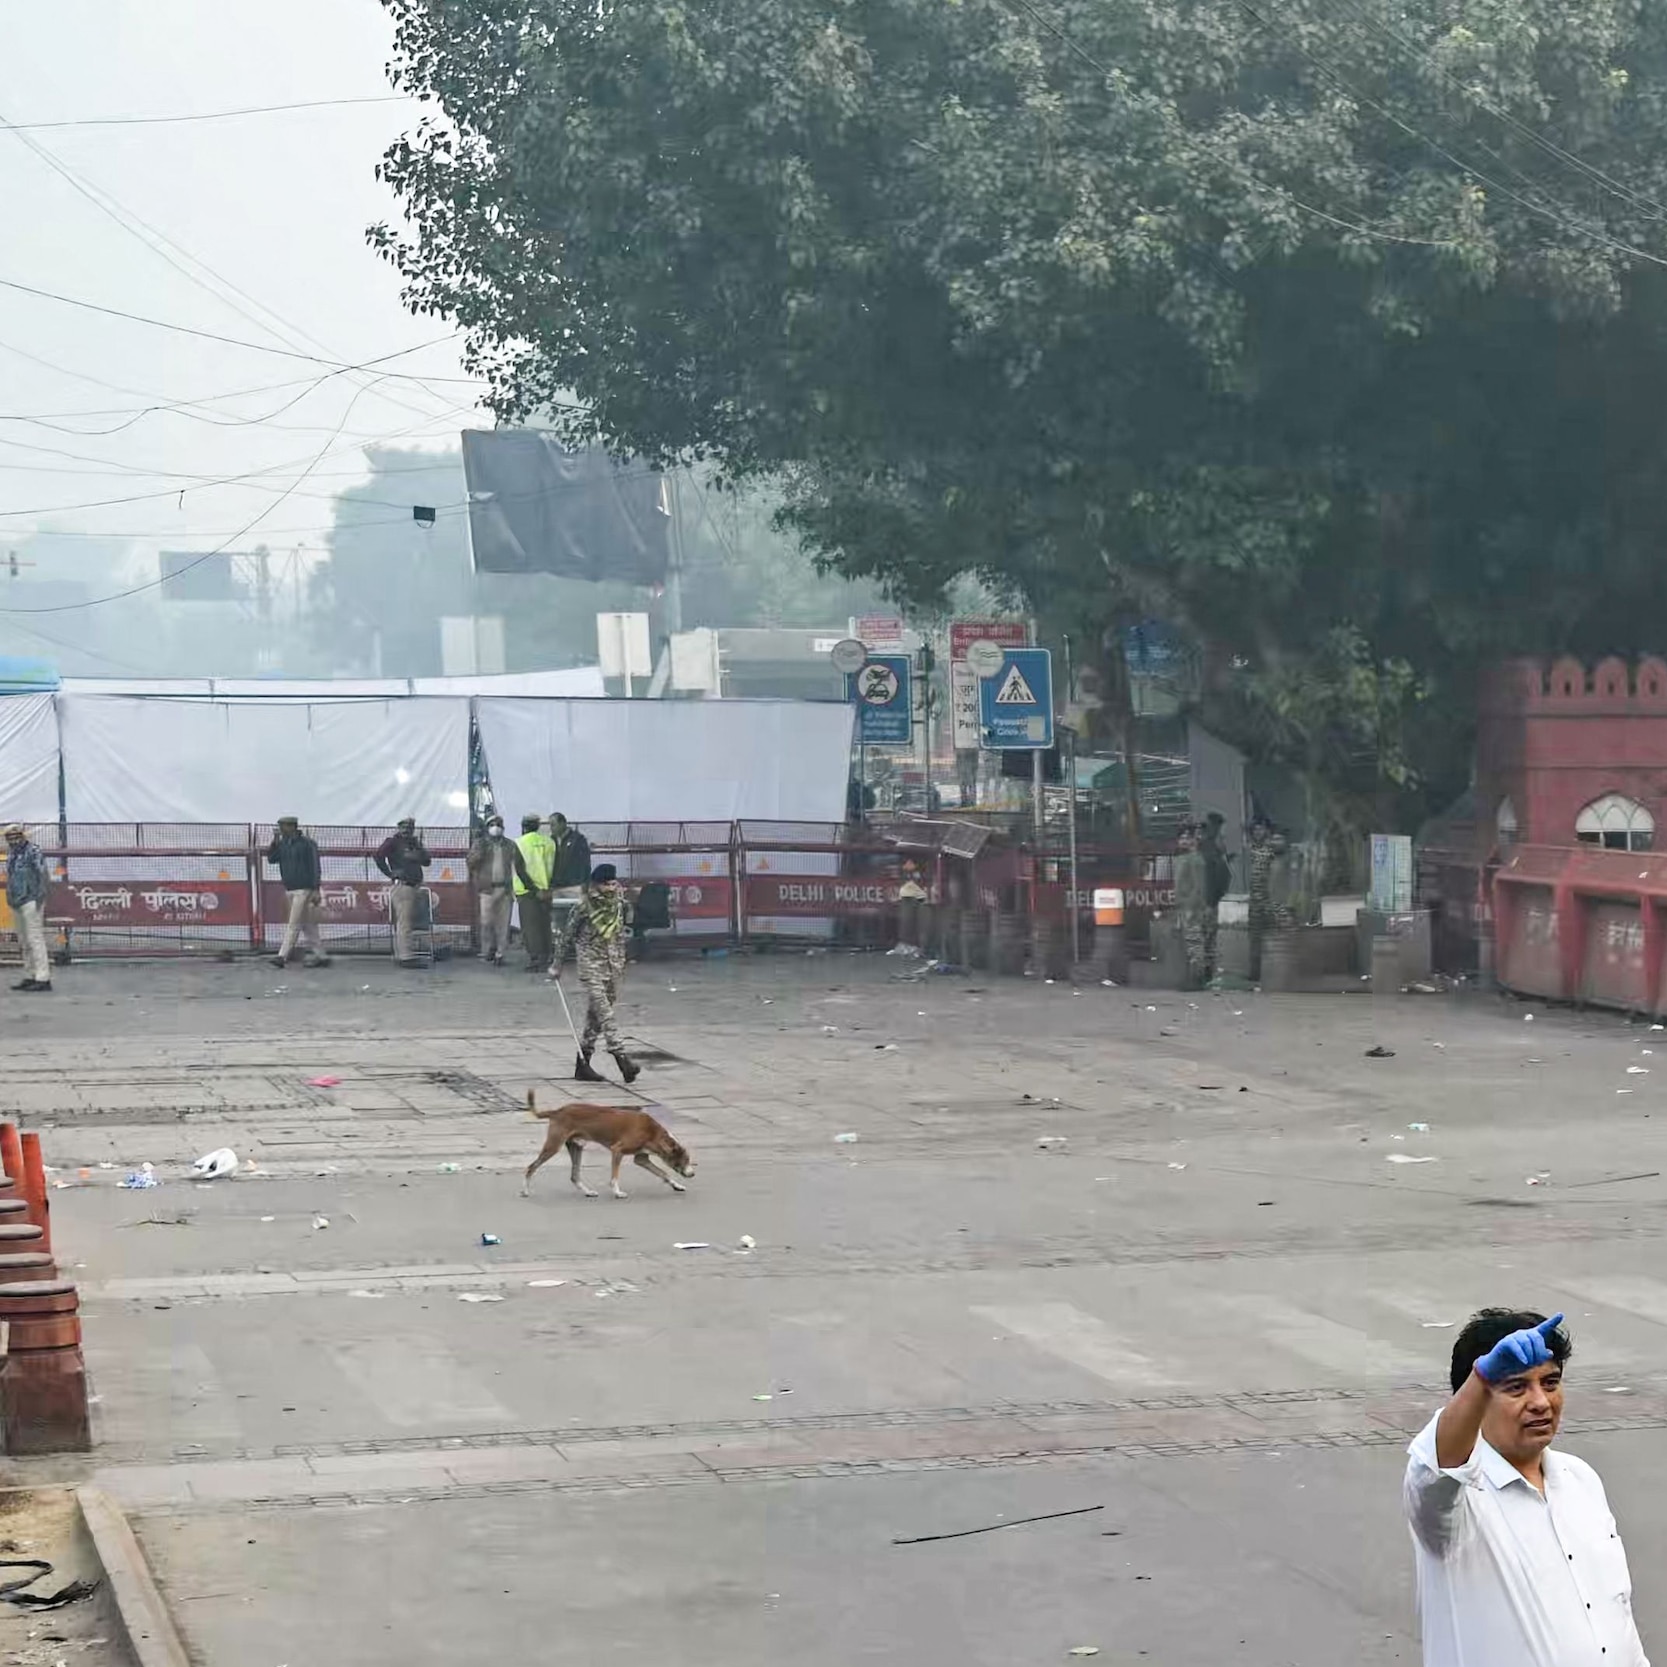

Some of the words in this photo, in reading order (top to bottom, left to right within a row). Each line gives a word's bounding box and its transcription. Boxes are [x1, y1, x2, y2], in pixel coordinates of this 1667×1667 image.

[75, 887, 133, 910] दिल्ली
[140, 887, 199, 911] पुलिस
[779, 884, 824, 901] DELHI
[835, 886, 884, 903] POLICE
[1126, 889, 1176, 907] POLICE
